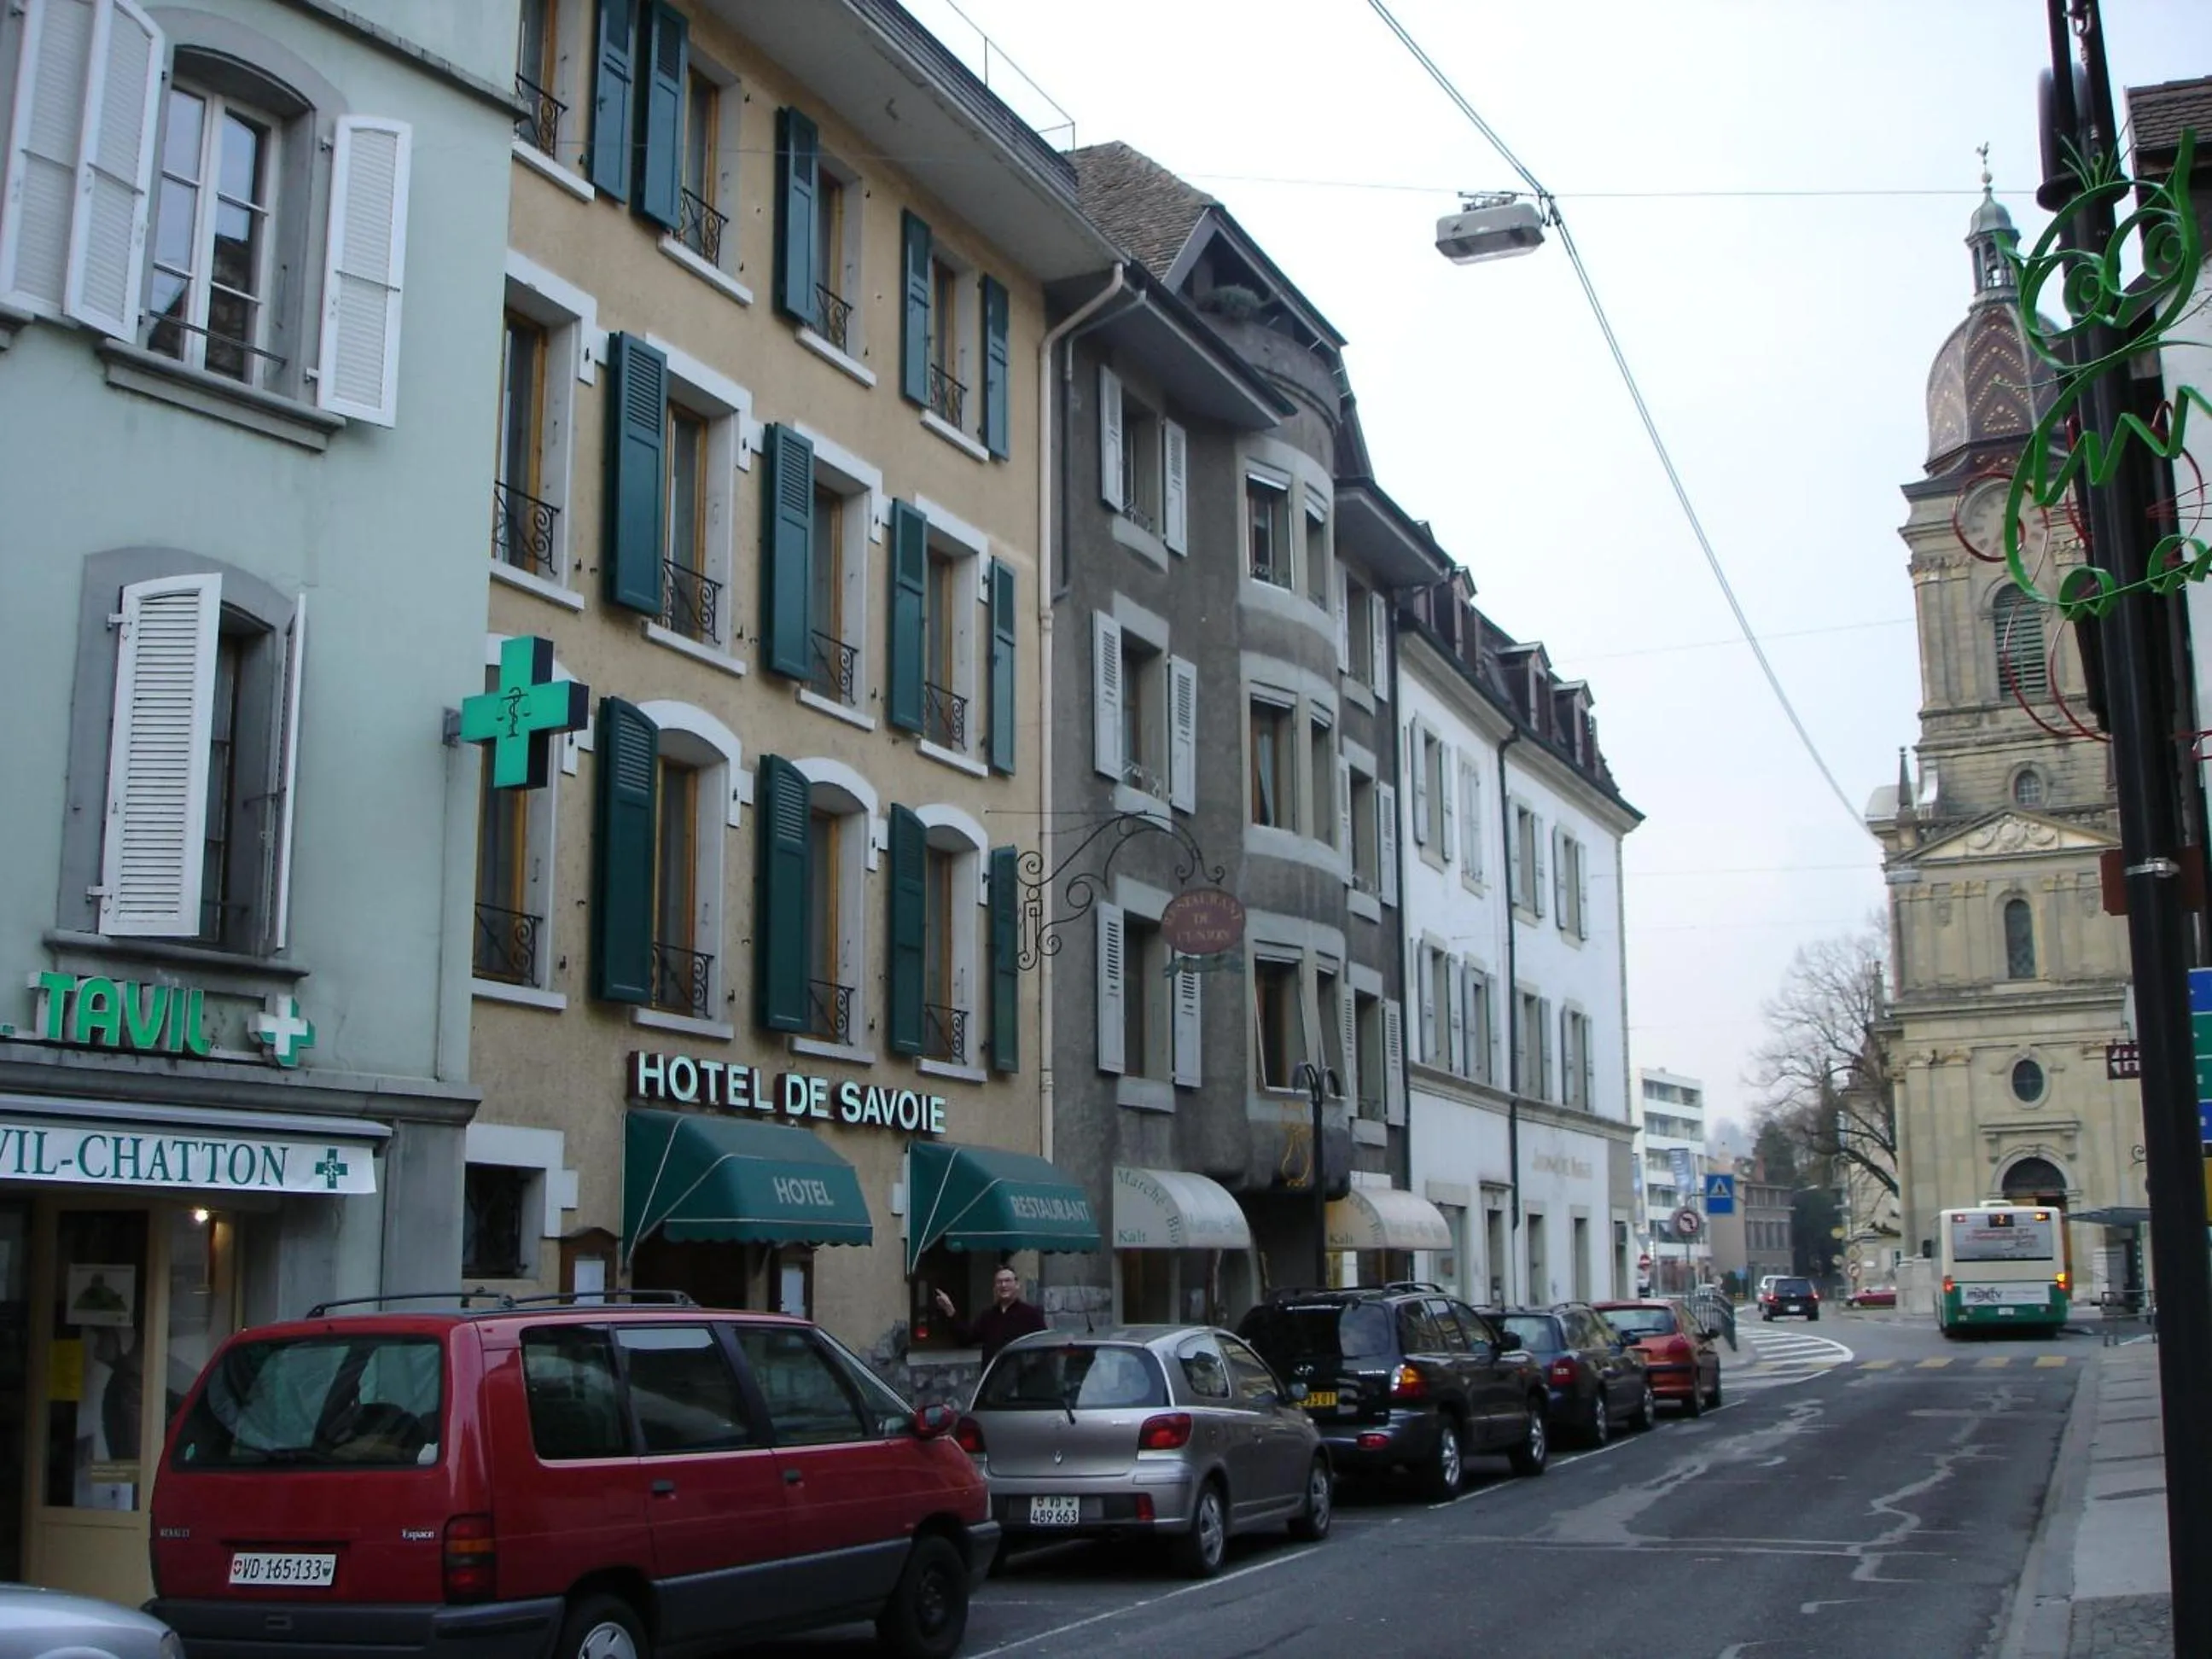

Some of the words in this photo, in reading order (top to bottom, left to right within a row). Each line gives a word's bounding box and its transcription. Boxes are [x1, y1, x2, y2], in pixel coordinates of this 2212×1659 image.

[41, 970, 209, 1056] TAVIL
[637, 1051, 774, 1109] HOTEL
[785, 1073, 830, 1118] DE
[841, 1080, 946, 1134] SAVOIE
[773, 1177, 835, 1206] HOTEL
[1010, 1195, 1091, 1221] RESTAURANT
